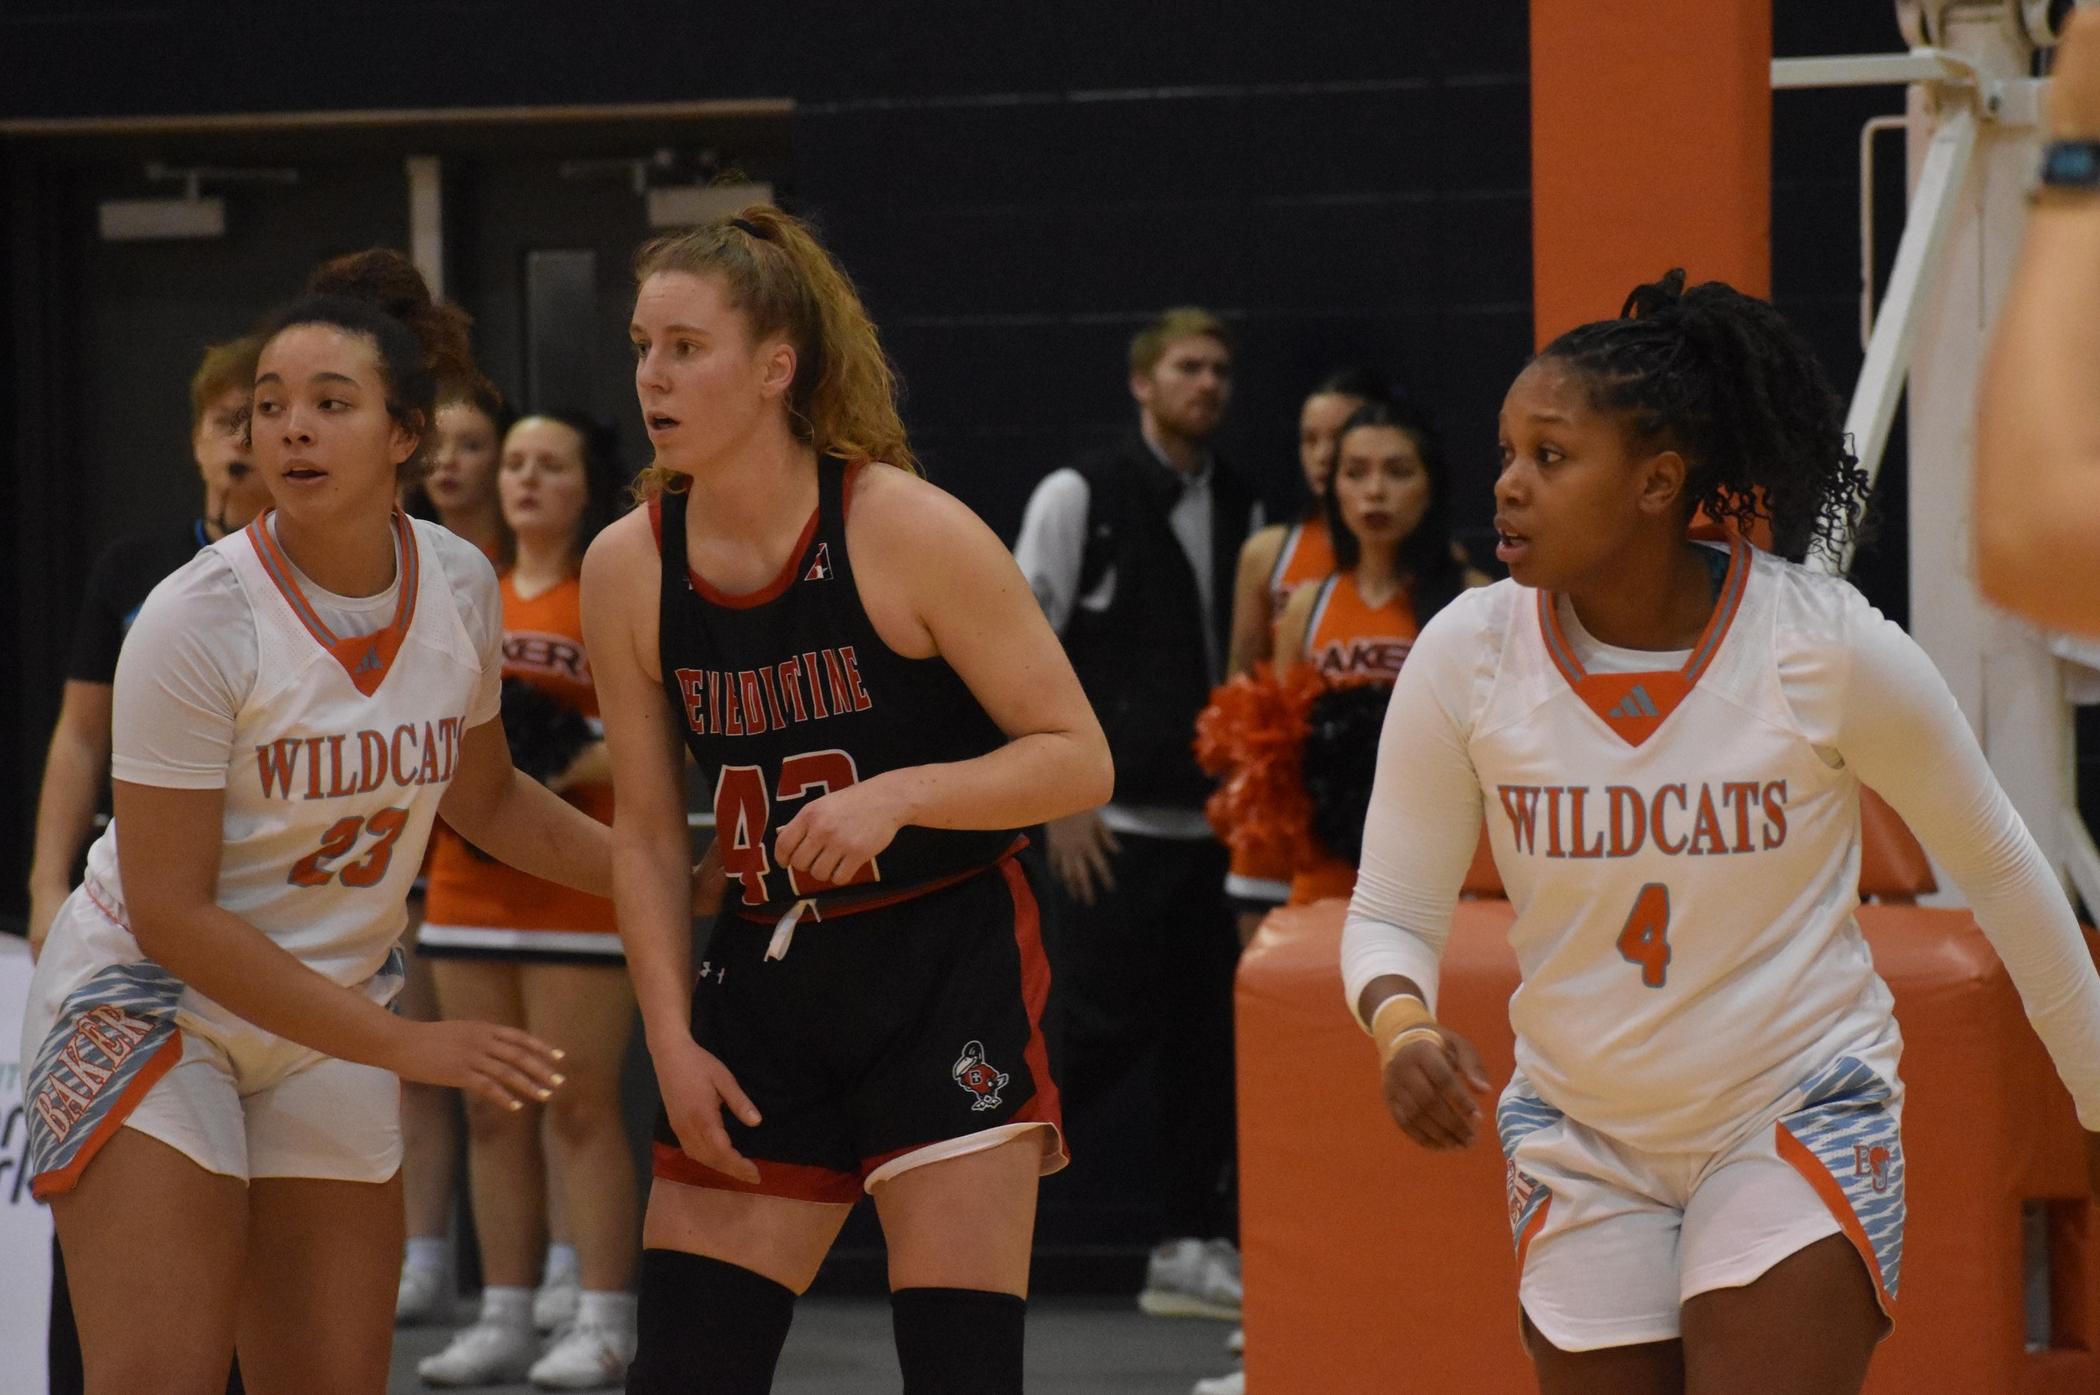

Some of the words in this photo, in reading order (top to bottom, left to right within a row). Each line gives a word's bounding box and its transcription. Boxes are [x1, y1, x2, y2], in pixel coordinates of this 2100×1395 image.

[256, 715, 467, 800] WILDCAT
[287, 806, 409, 888] 23
[1497, 779, 1788, 859] WILDCATS
[1616, 882, 1672, 989] 4
[35, 1003, 155, 1144] BAKER
